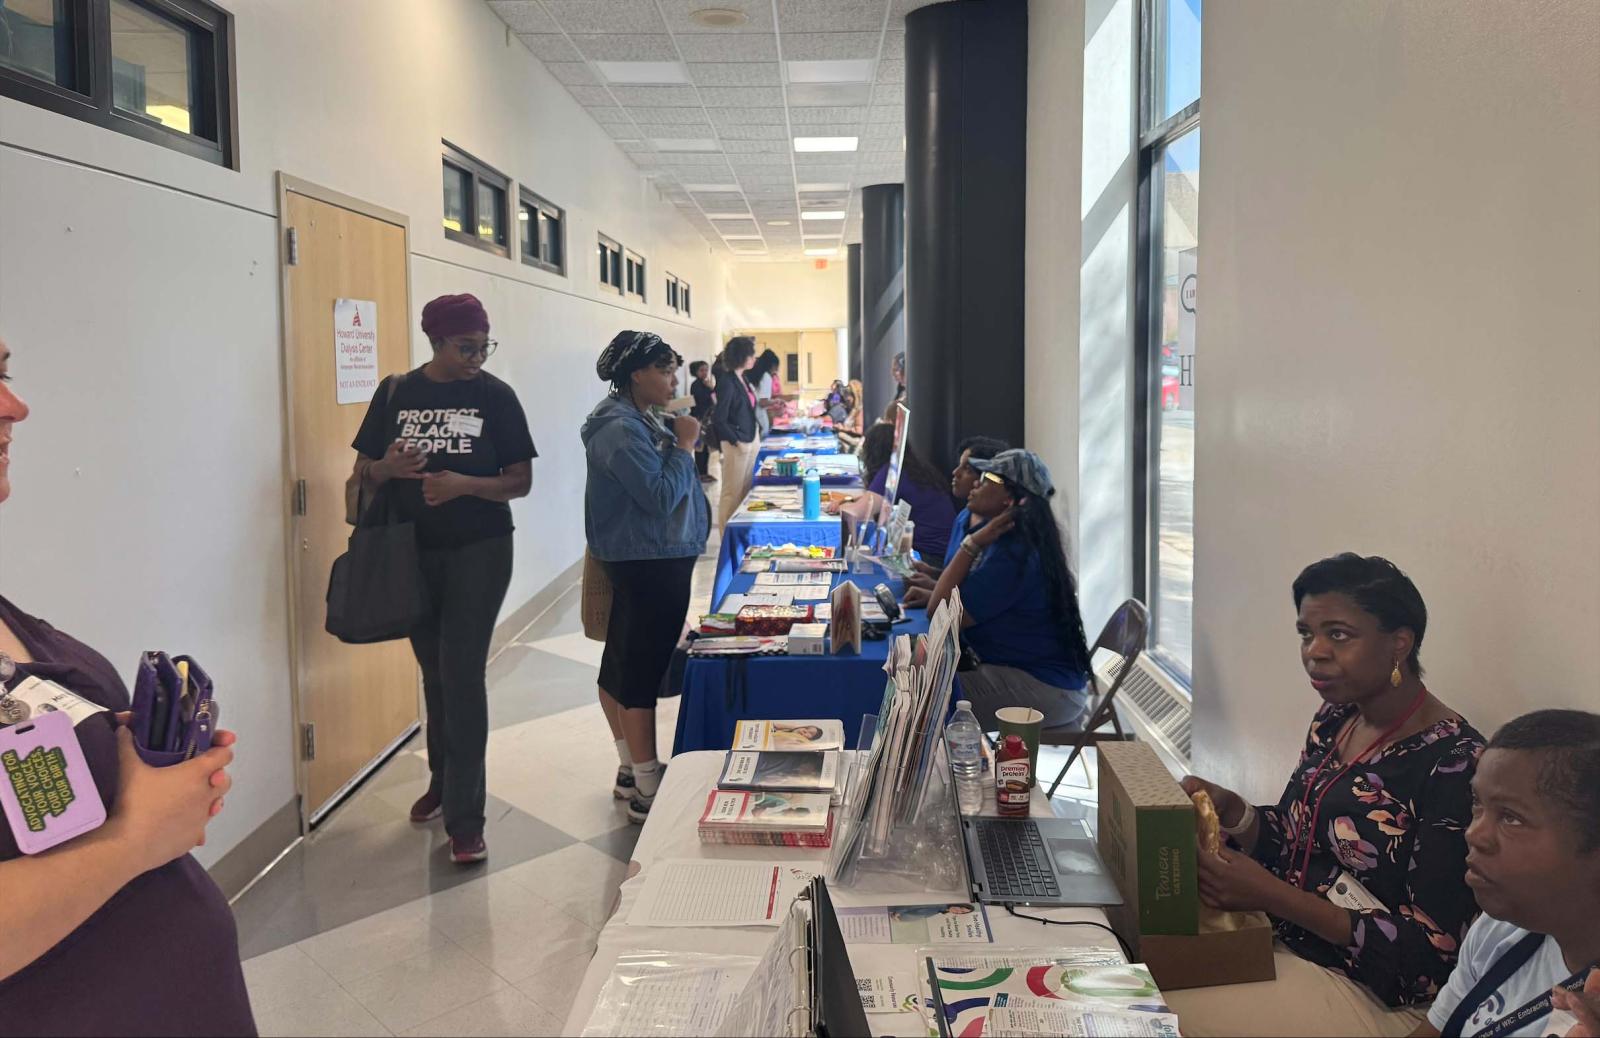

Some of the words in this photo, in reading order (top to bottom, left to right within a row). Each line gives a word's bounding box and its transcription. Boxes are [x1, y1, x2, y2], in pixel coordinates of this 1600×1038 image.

[337, 329, 354, 339] Howard
[355, 329, 375, 342] University
[359, 343, 373, 354] Center
[395, 437, 472, 454] EOPLE
[3, 752, 19, 772] FOR
[12, 772, 43, 830] ADVOCATING
[33, 790, 50, 815] YOUR
[47, 791, 64, 815] YOUR
[55, 779, 73, 804] YOUR
[1156, 846, 1171, 900] Panera
[1173, 848, 1181, 895] CATERING
[1517, 998, 1549, 1020] Embracing
